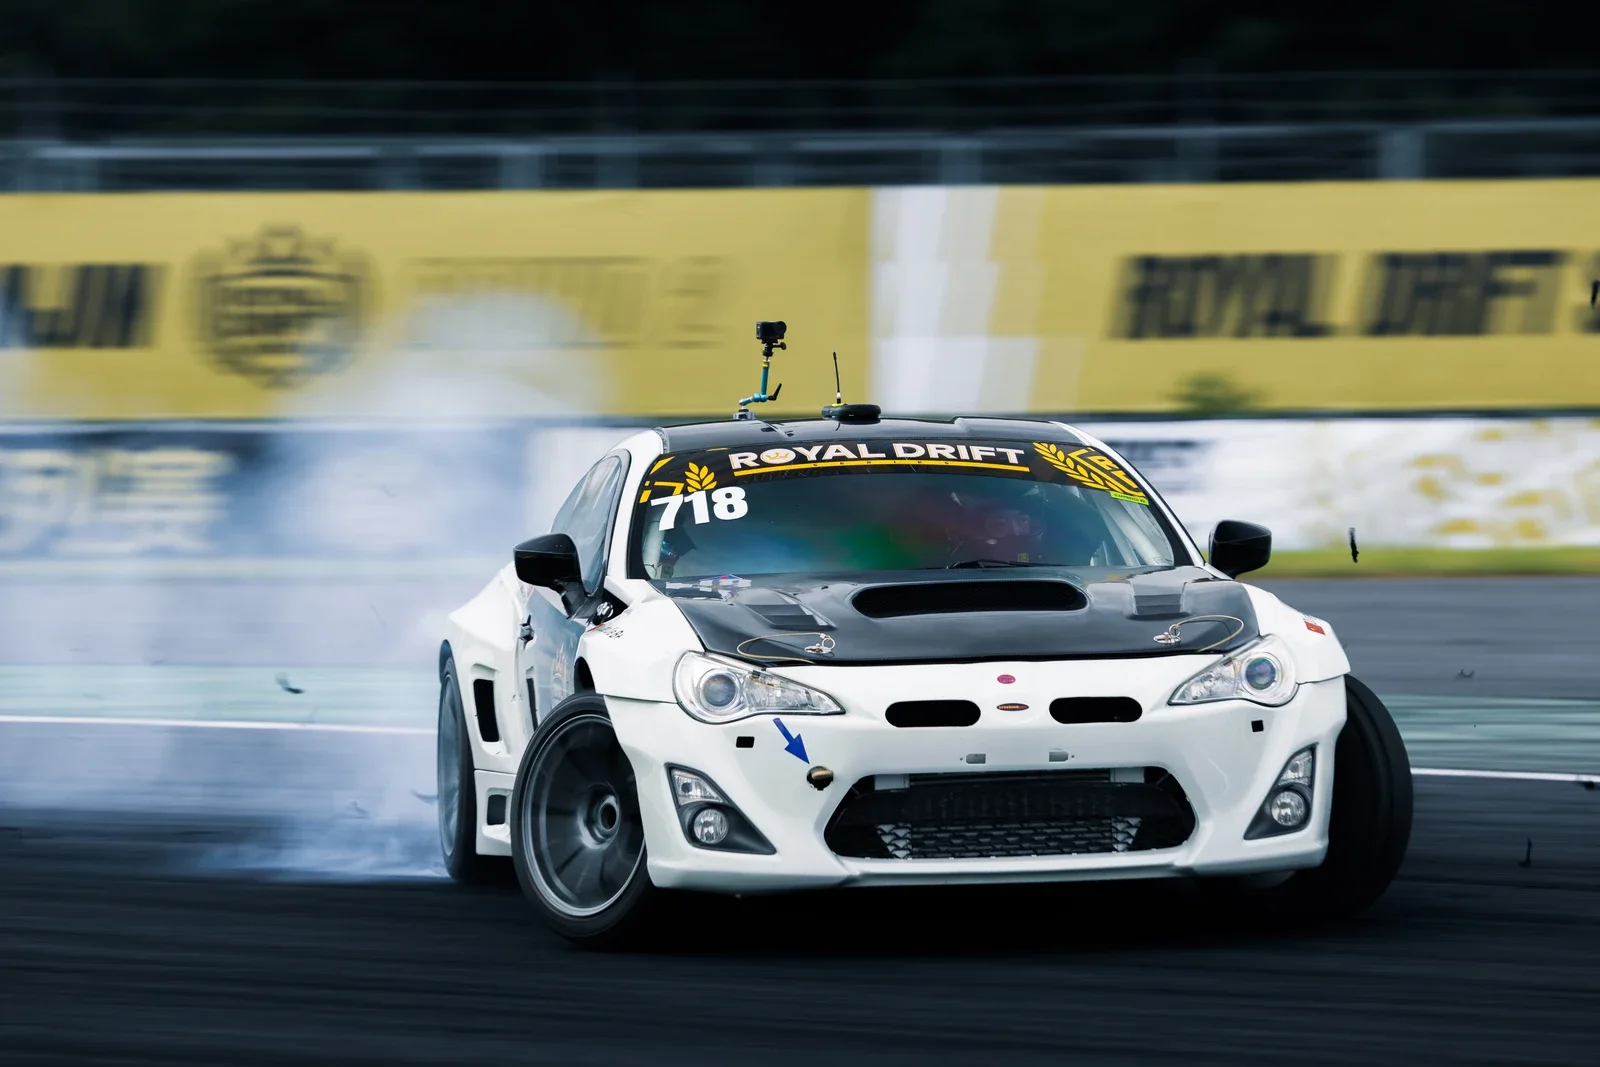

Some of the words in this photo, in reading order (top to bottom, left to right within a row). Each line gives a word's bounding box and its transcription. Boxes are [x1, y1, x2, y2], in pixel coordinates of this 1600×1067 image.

[728, 443, 887, 470] ROYAL
[892, 442, 1025, 465] DRIFT
[650, 486, 749, 532] 718
